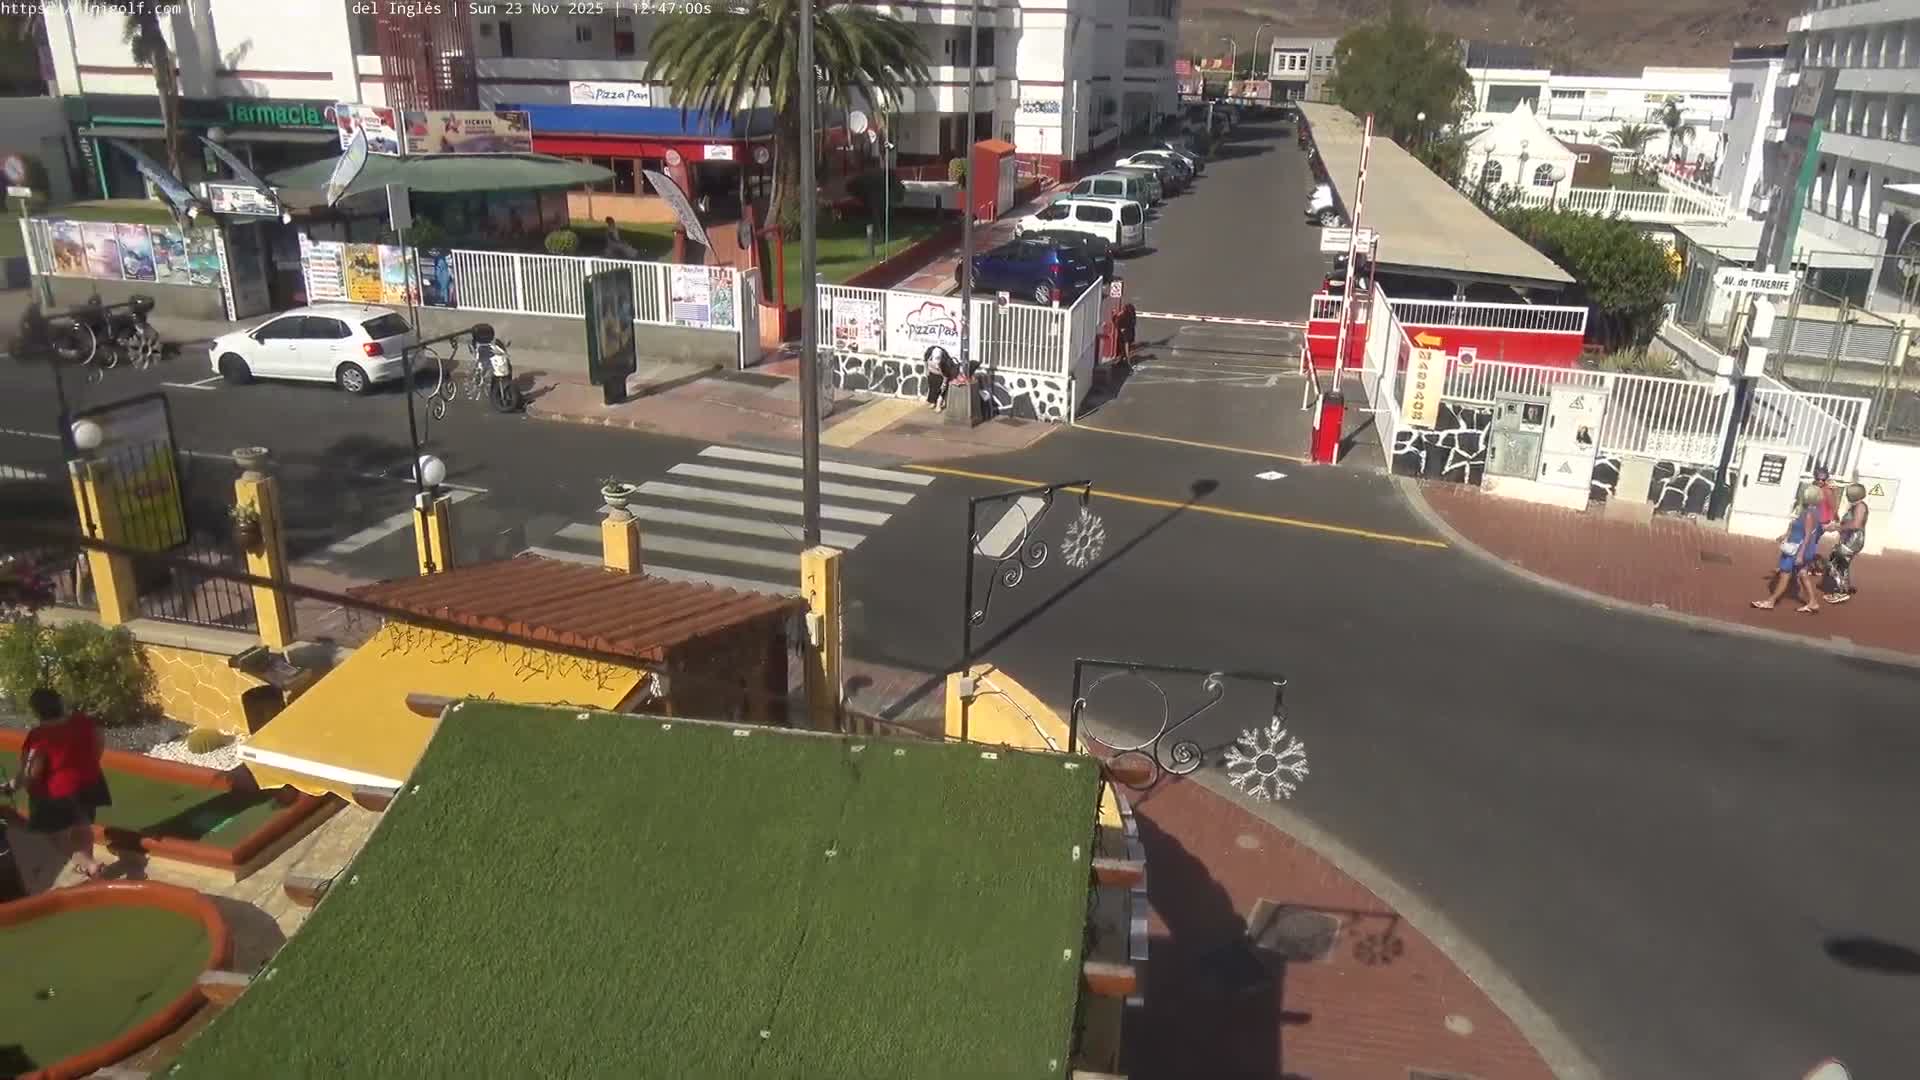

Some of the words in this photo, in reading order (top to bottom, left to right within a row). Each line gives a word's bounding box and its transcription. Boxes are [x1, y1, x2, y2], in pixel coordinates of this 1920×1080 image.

[596, 88, 625, 101] Pizza
[627, 89, 648, 101] Pan
[1722, 276, 1735, 287] AV.
[1737, 278, 1748, 287] de
[1750, 279, 1790, 291] TENERIFE
[908, 323, 937, 339] Pizza
[939, 323, 959, 338] Pan
